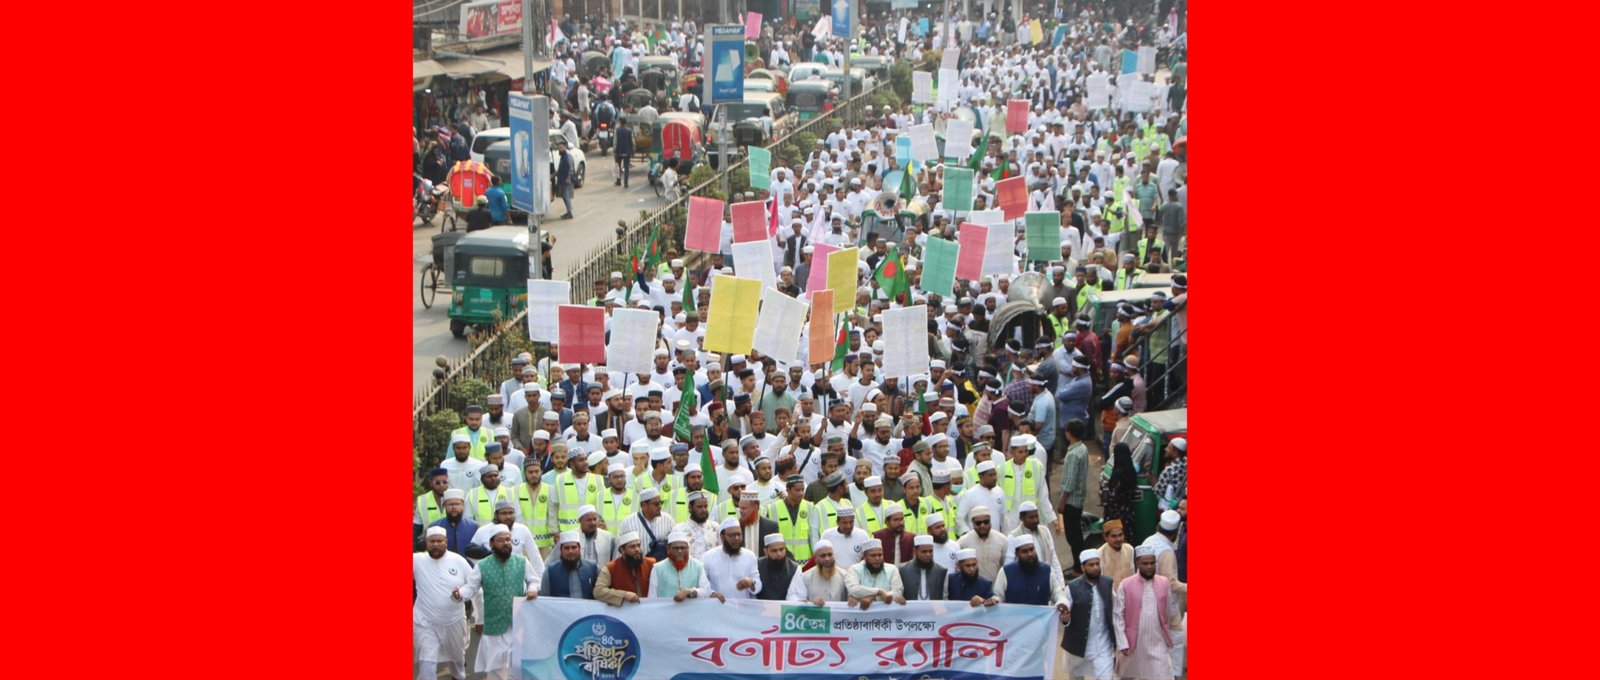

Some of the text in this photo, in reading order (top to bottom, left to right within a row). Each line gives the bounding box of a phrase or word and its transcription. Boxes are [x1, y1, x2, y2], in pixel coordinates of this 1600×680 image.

[833, 618, 936, 632] প্রতিষ্ঠাবার্ষিকী উপলক্ষ্যে
[687, 625, 850, 671] বর্ণাঢ্য
